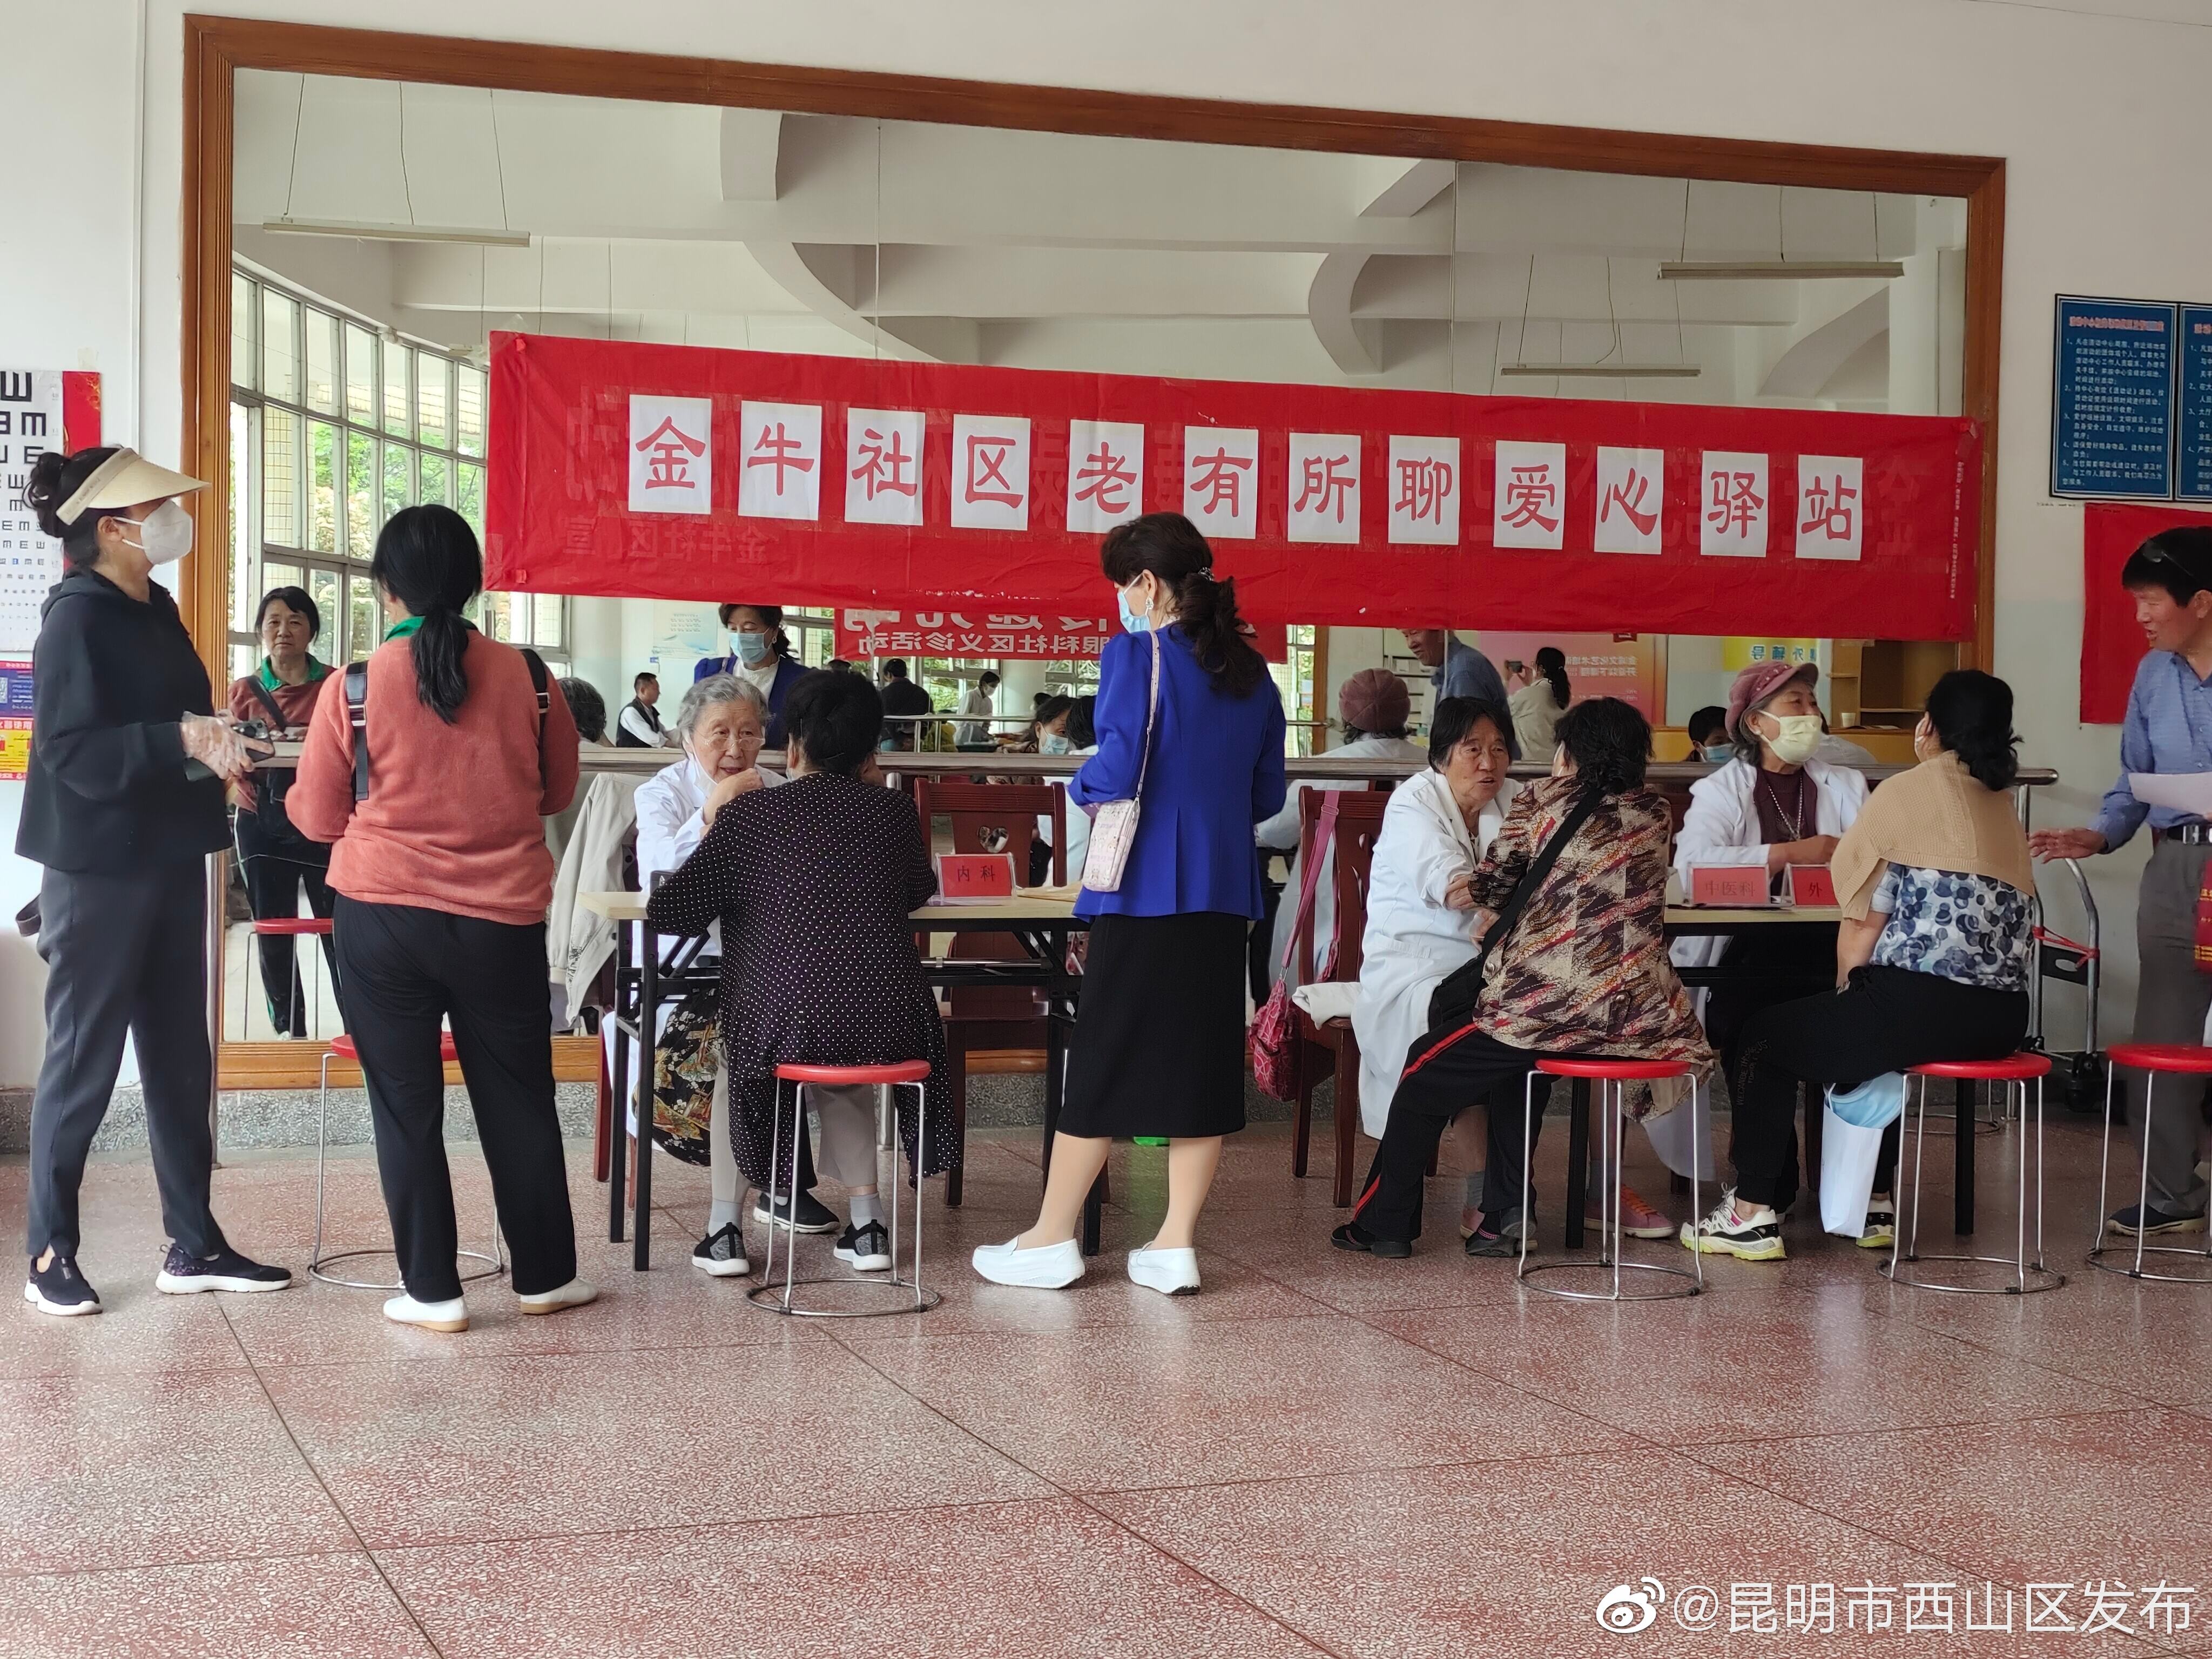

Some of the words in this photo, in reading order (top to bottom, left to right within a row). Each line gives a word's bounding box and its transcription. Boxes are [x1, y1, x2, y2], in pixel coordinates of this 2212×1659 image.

[635, 416, 1857, 541] 金牛社区老有所聊爱心驿站
[957, 865, 995, 882] 内科
[1705, 880, 1755, 897] 中医科
[1809, 882, 1823, 898] 外
